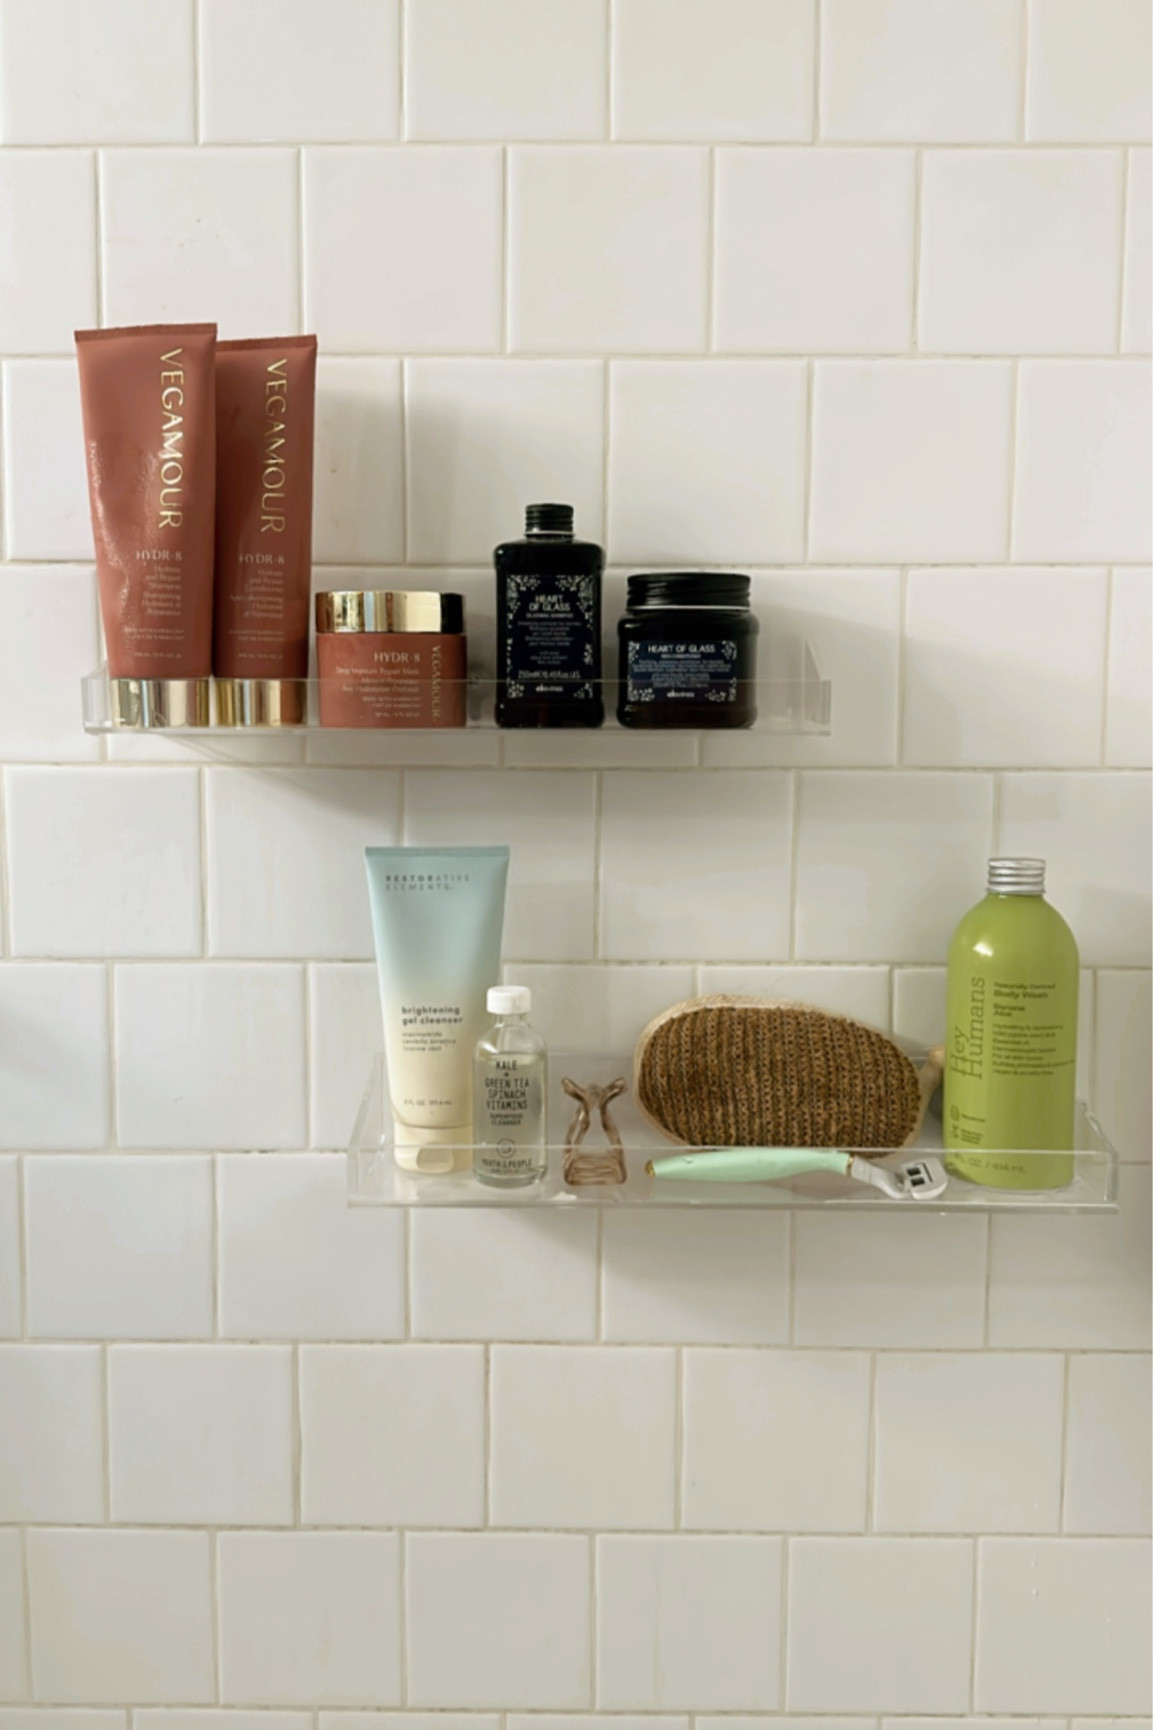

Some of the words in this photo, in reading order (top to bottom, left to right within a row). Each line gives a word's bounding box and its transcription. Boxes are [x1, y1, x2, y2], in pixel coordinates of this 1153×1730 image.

[158, 348, 184, 529] VEGAMOUR
[260, 358, 288, 533] VEGAMOUR
[534, 595, 564, 603] HEART
[529, 603, 540, 611] OF
[542, 603, 571, 611] GLASS
[648, 644, 674, 653] HEART
[675, 644, 687, 653] OF
[688, 644, 716, 653] GLASS
[431, 645, 443, 718] VEGAMOUR
[385, 874, 470, 882] RESTORATIVE
[993, 989, 1020, 999] Body
[1021, 991, 1048, 999] Wash
[401, 1006, 461, 1016] brightening
[402, 1016, 418, 1026] gel
[420, 1016, 464, 1025] cleanser
[962, 977, 986, 1080] Humans
[949, 1025, 969, 1077] Hey
[495, 1060, 518, 1071] KALE
[484, 1077, 512, 1088] GREEN
[513, 1078, 530, 1088] TEA
[488, 1088, 527, 1099] SPINACH
[486, 1100, 528, 1110] VITAMINS
